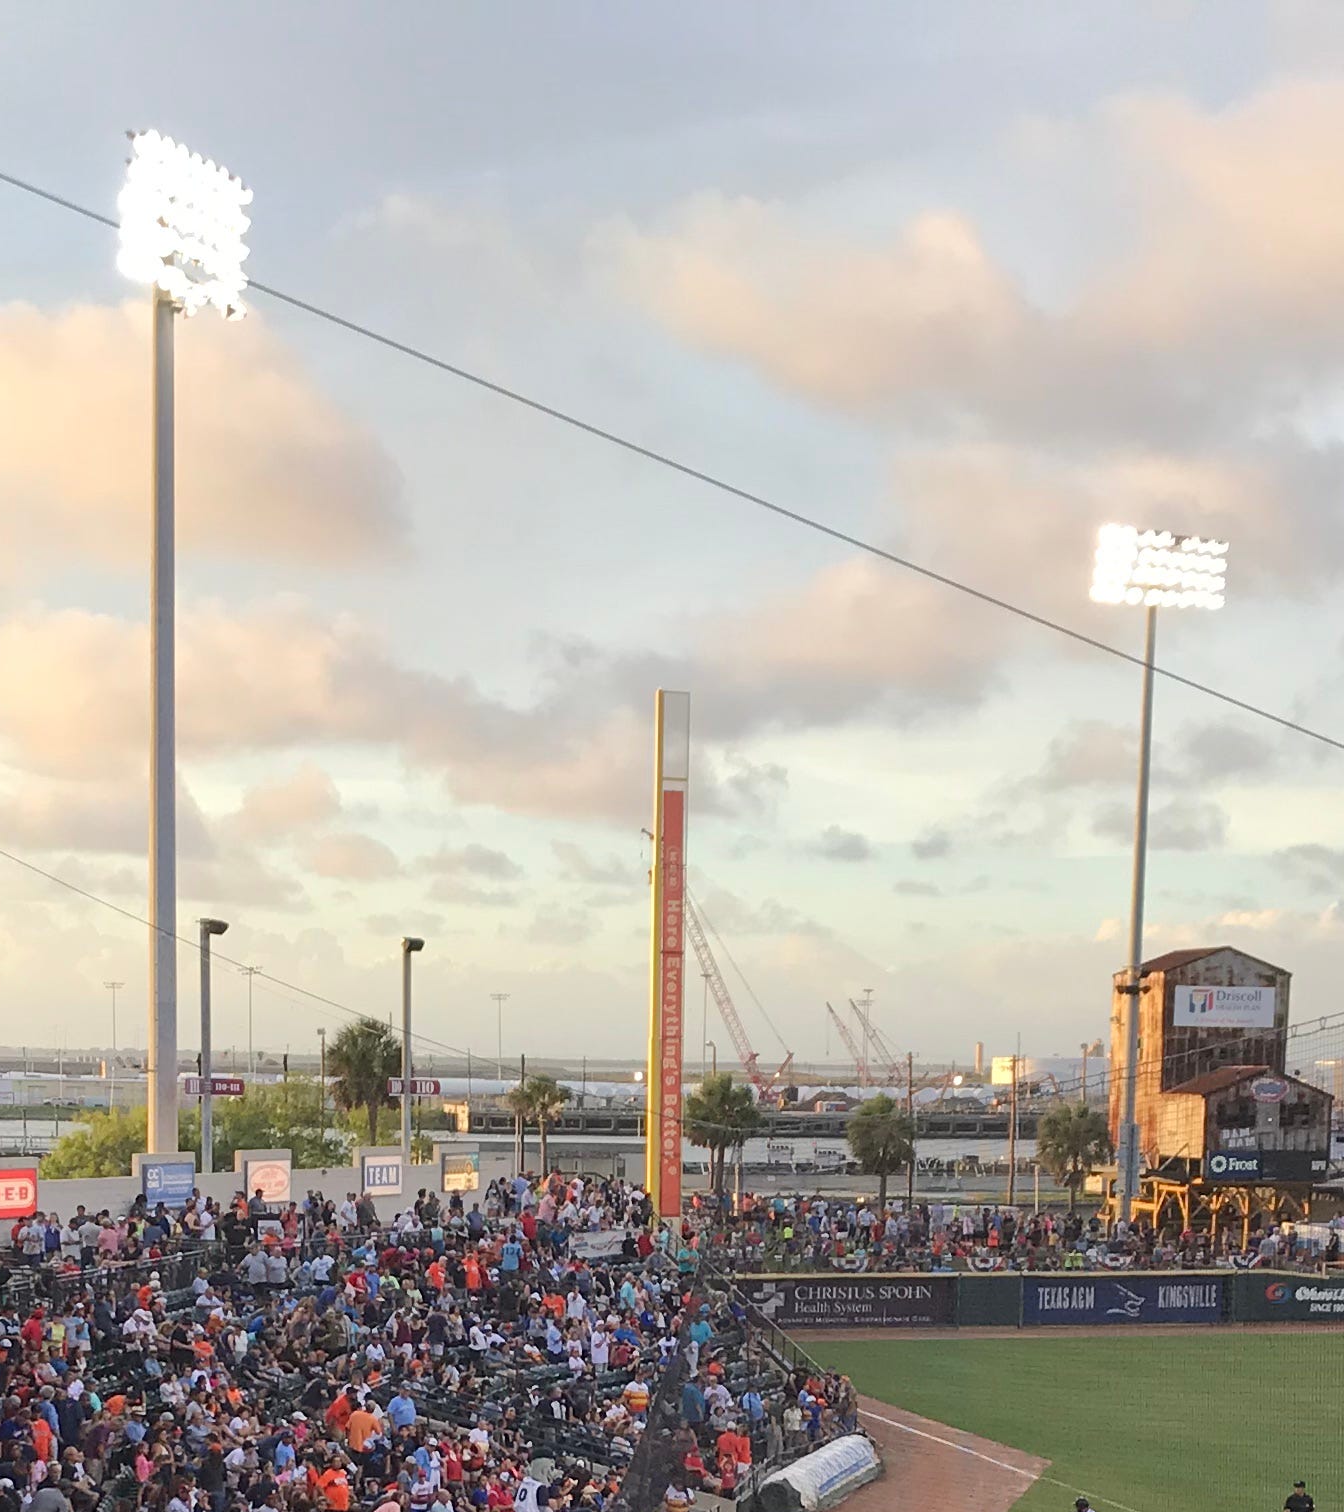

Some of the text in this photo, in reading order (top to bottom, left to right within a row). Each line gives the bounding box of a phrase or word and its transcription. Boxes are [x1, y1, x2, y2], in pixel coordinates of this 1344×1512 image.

[667, 899, 681, 948] Here
[1216, 990, 1262, 1002] Driscoll
[663, 956, 680, 1087] Everything's
[415, 1080, 435, 1094] 110
[1228, 1157, 1258, 1171] Frost
[369, 1166, 397, 1184] TEAM
[794, 1285, 932, 1300] CHRISTUS SPOHN
[1038, 1287, 1070, 1310] TEXAS
[1158, 1284, 1217, 1309] KINGSVILLE
[794, 1302, 873, 1316] Health System
[519, 1488, 528, 1501] 0
